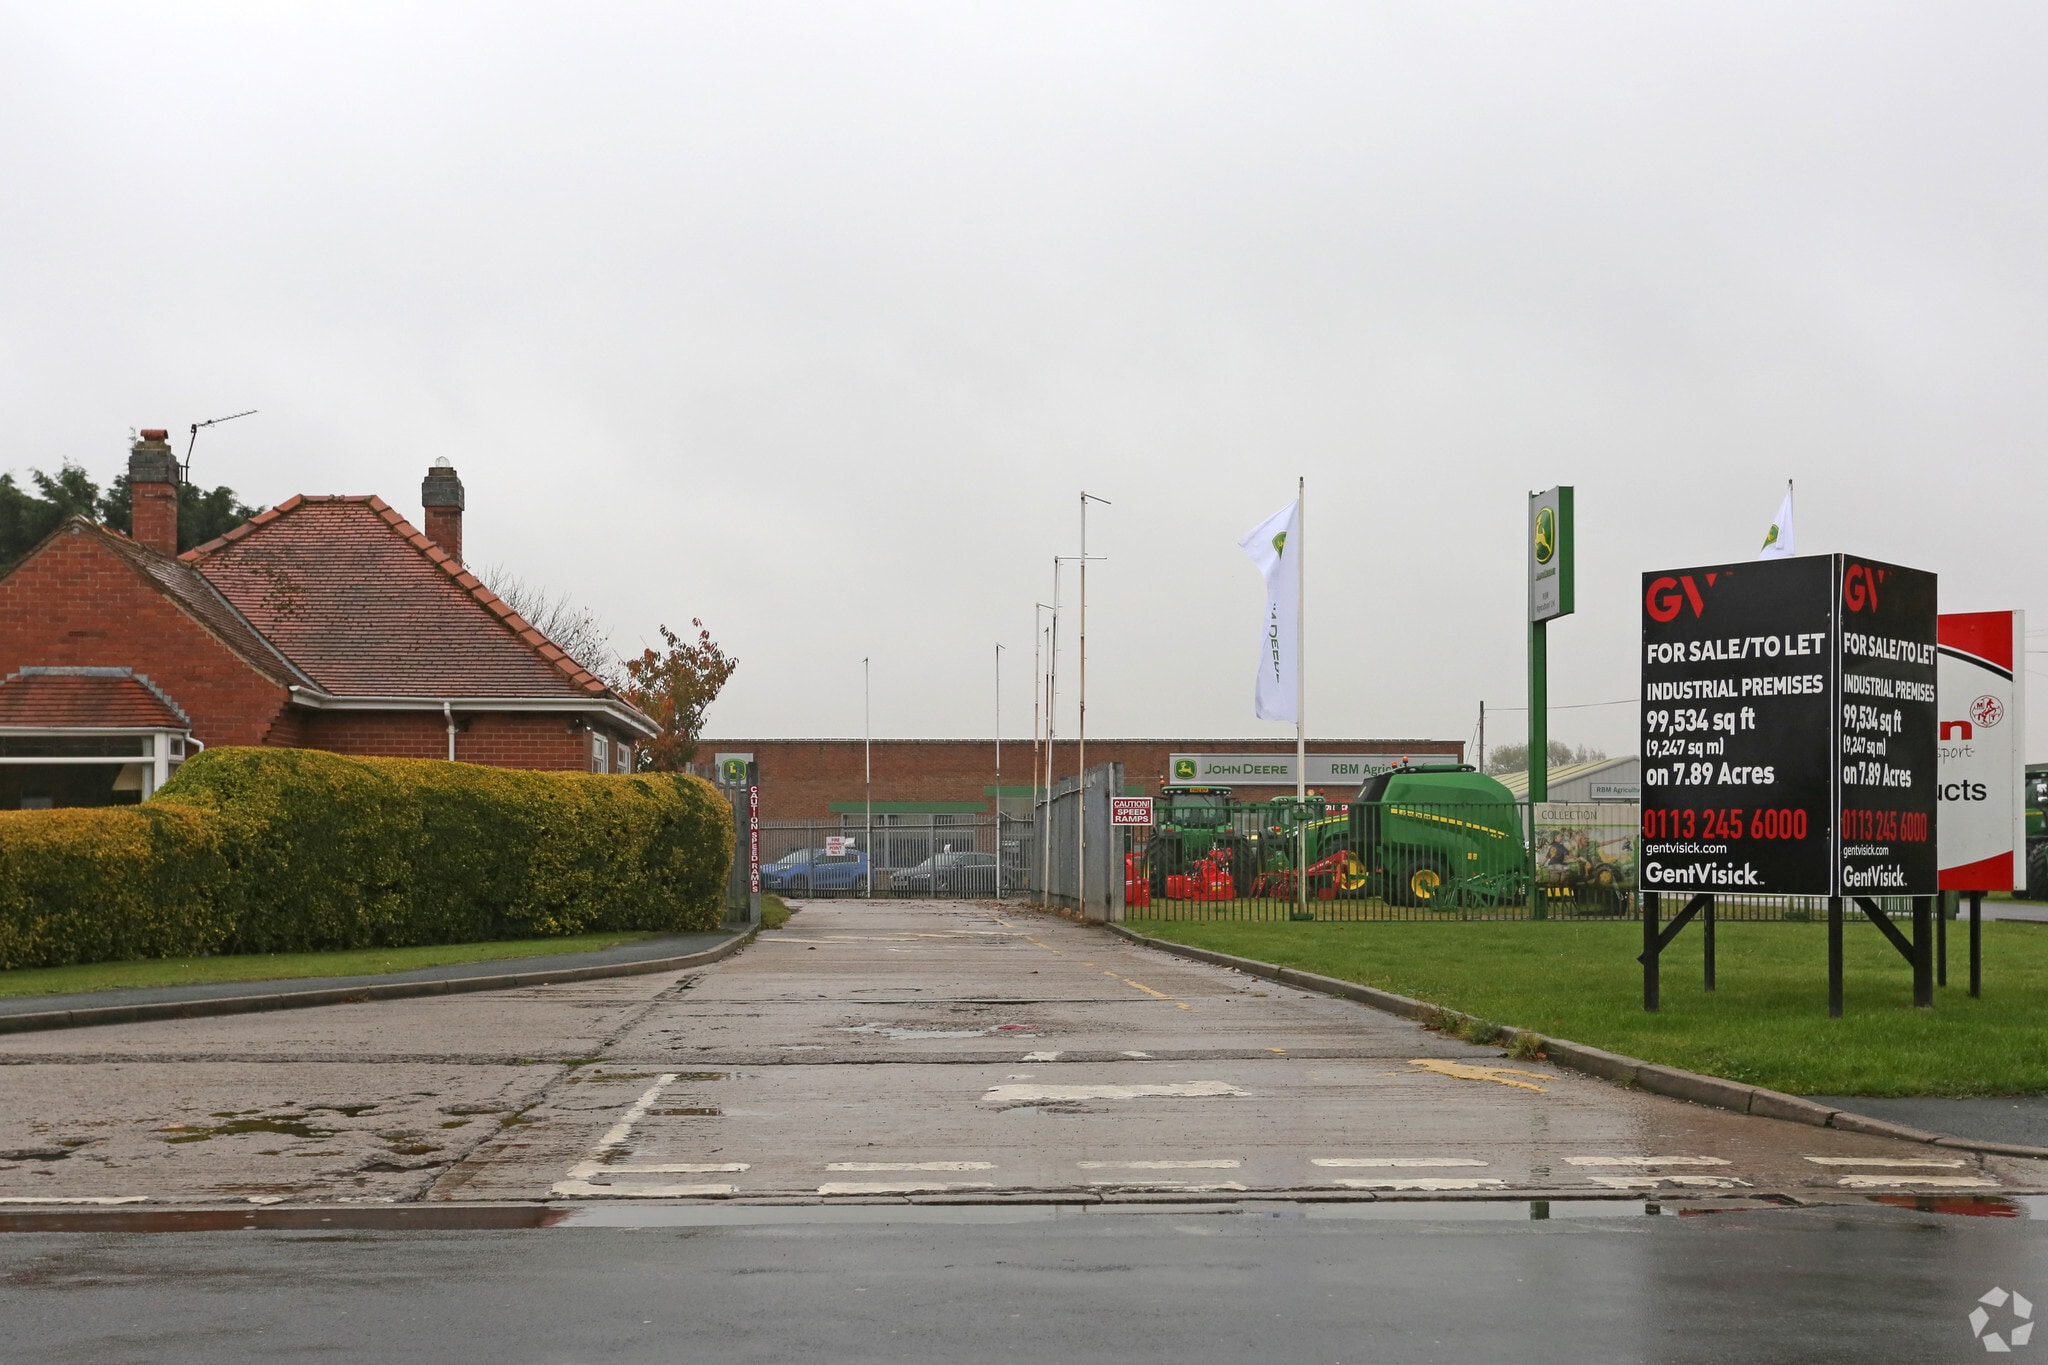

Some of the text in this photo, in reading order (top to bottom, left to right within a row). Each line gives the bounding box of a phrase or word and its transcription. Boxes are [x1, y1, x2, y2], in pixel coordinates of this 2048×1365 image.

[1647, 633, 1826, 664] FOR SALE/TO LET
[1843, 631, 1935, 665] FOR SALE/TO LET
[1647, 674, 1824, 701] INDUSTRIAL PREMISES
[1843, 673, 1935, 703] INDUSTRIAL PREMISES
[1646, 706, 1756, 737] 99,534 sq ft
[1843, 704, 1902, 737] 99,534 sq ft
[1646, 737, 1724, 758] (9,247 sq m)
[1843, 734, 1886, 758] (9,247 sq m)
[1204, 763, 1288, 775] JOHN DEERE
[1331, 763, 1393, 777] RBM Agric
[1646, 761, 1775, 786] on 7.89 Acres
[1843, 761, 1912, 788] on 7.89 Acres
[1114, 800, 1150, 808] CAUTION!
[1117, 808, 1147, 816] SPEED
[1541, 810, 1597, 820] COLLECTION
[1115, 815, 1149, 823] RAMPS
[1643, 808, 1808, 840] 0113 245 6000
[1842, 808, 1927, 842] 0113 245 6000
[750, 786, 759, 893] CAUTION SPEED RAMPS
[1646, 842, 1727, 856] gentvisick.com
[1843, 844, 1889, 859] gentvisick.com
[1646, 861, 1758, 886] GentVisick
